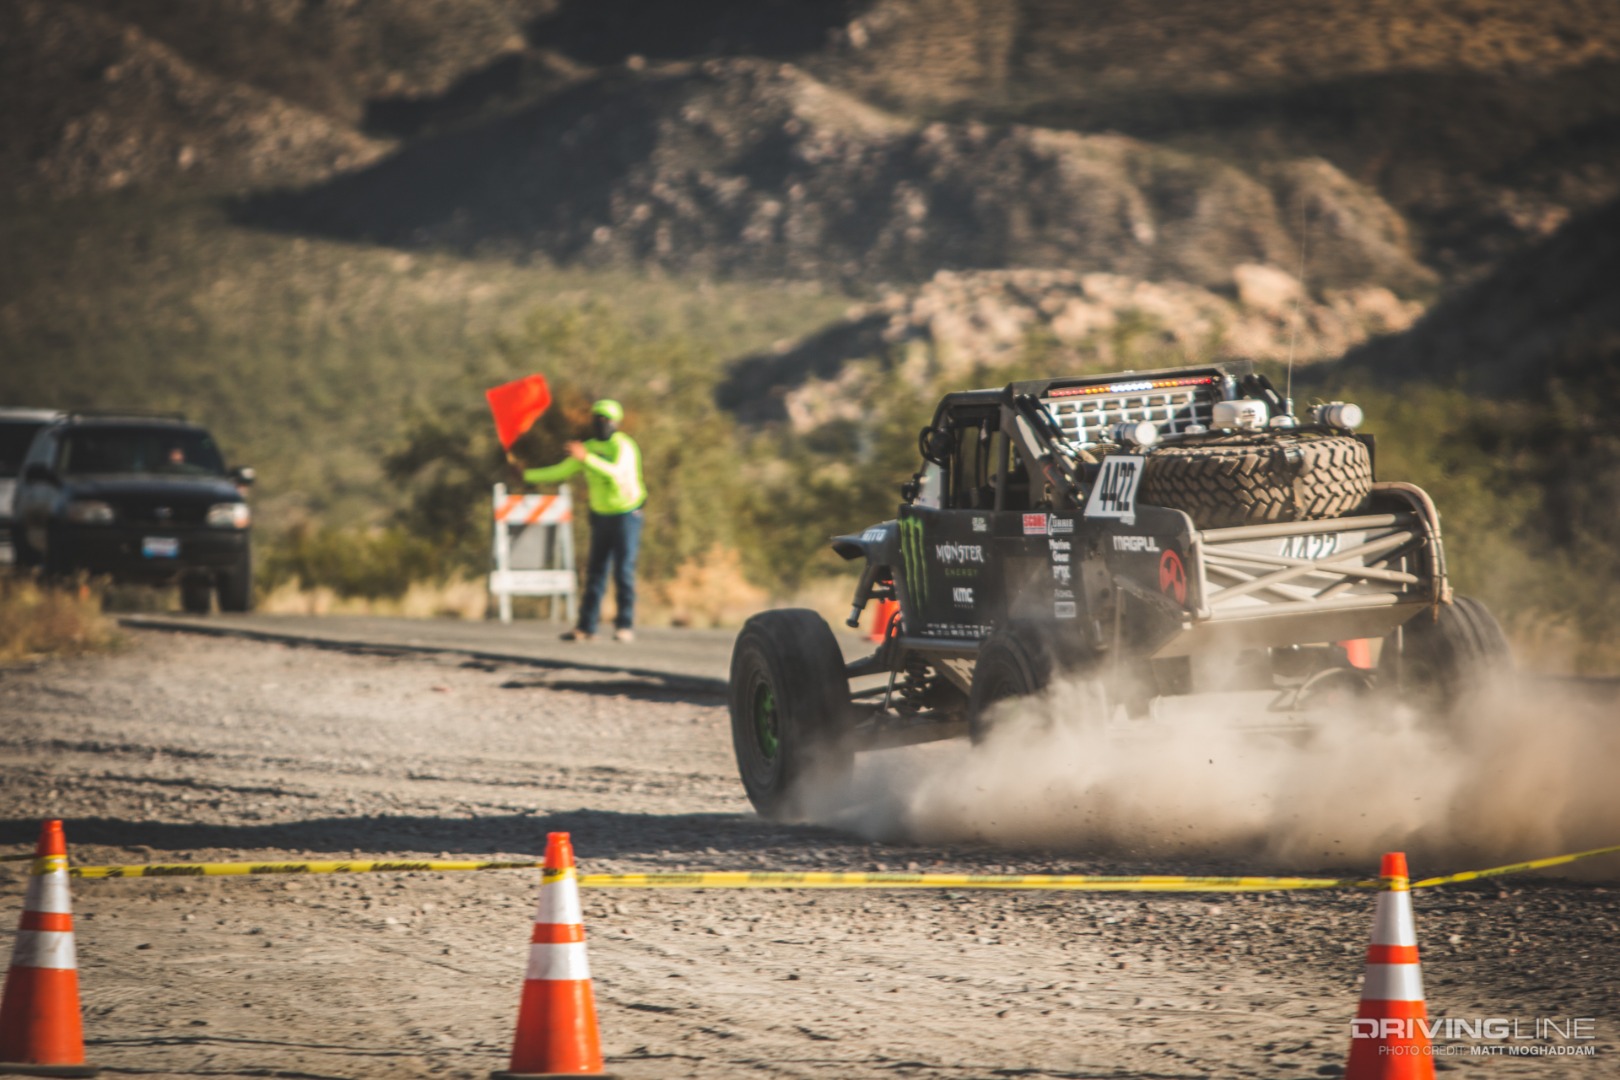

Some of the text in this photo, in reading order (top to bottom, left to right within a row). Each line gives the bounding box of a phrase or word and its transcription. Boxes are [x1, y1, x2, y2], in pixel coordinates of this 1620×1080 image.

[1100, 462, 1136, 511] 4422
[936, 541, 984, 563] MONSTER
[1113, 535, 1160, 552] MAGPUL
[952, 587, 974, 603] KMC
